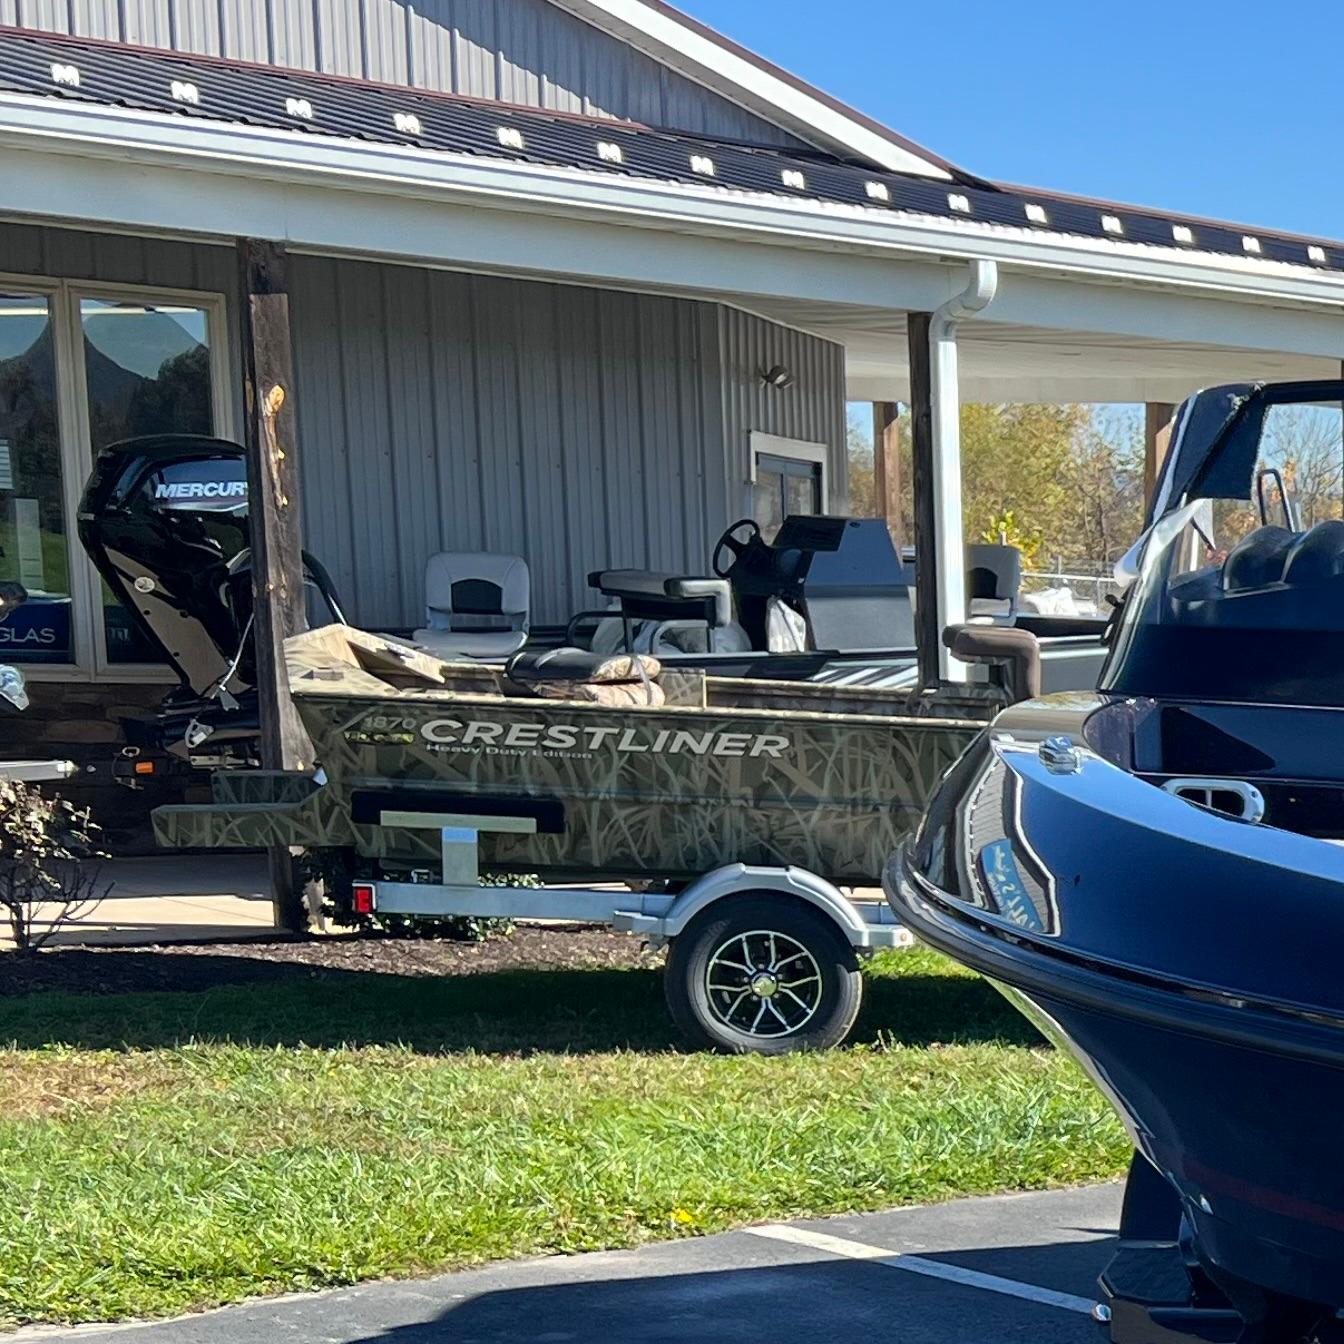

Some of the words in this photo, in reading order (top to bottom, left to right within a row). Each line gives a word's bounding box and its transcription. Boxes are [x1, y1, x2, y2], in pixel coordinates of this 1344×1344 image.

[421, 719, 790, 758] CRESTLINER
[426, 743, 481, 755] Heavy
[486, 746, 527, 758] Duty
[532, 750, 593, 760] Edition
